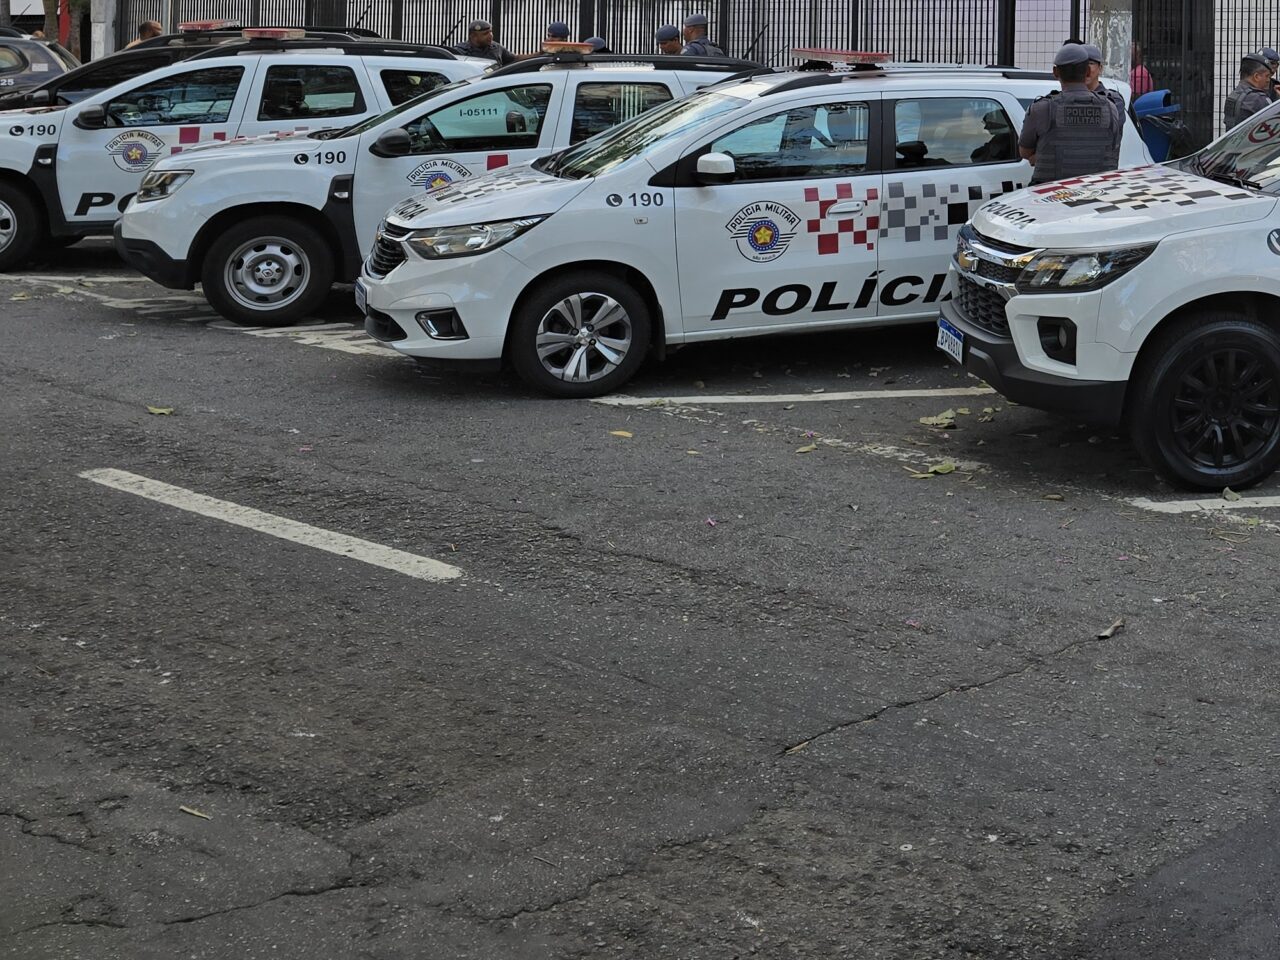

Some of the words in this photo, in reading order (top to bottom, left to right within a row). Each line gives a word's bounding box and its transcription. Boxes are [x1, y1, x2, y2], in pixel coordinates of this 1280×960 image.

[459, 107, 498, 117] I-05111
[1066, 116, 1101, 124] MILITAR
[27, 124, 57, 136] 190
[137, 132, 161, 147] MILITAR
[314, 150, 347, 165] 190
[441, 161, 468, 178] MILITAR
[628, 192, 664, 207] 190
[765, 203, 796, 225] MILITAR
